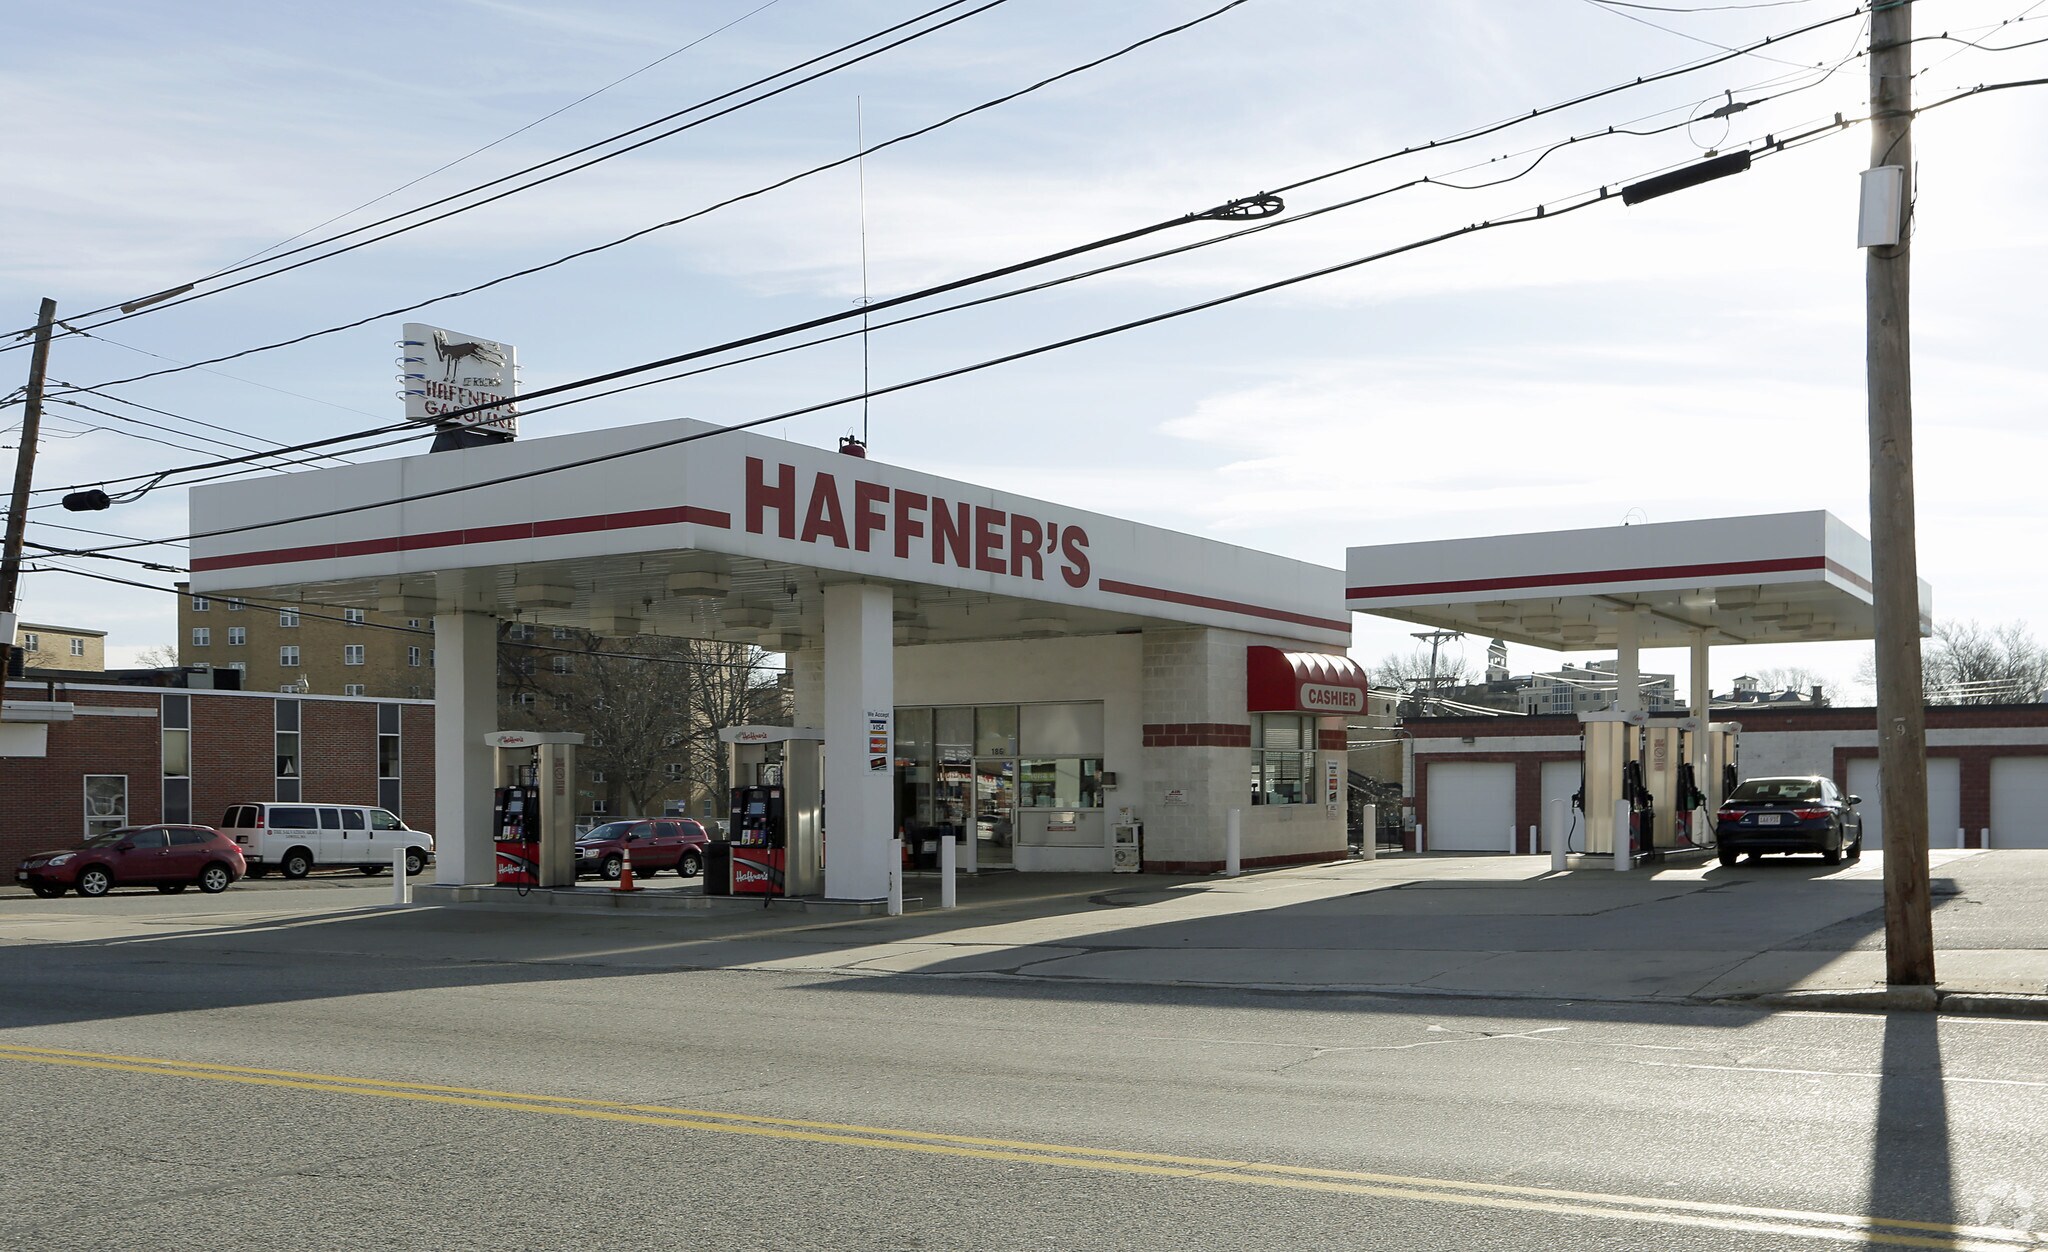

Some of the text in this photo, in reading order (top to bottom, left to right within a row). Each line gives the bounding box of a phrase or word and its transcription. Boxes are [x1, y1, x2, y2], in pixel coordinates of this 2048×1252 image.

[745, 455, 1090, 588] HAFFNER'S
[1309, 689, 1356, 707] CASHIER
[736, 870, 768, 882] Haffner's
